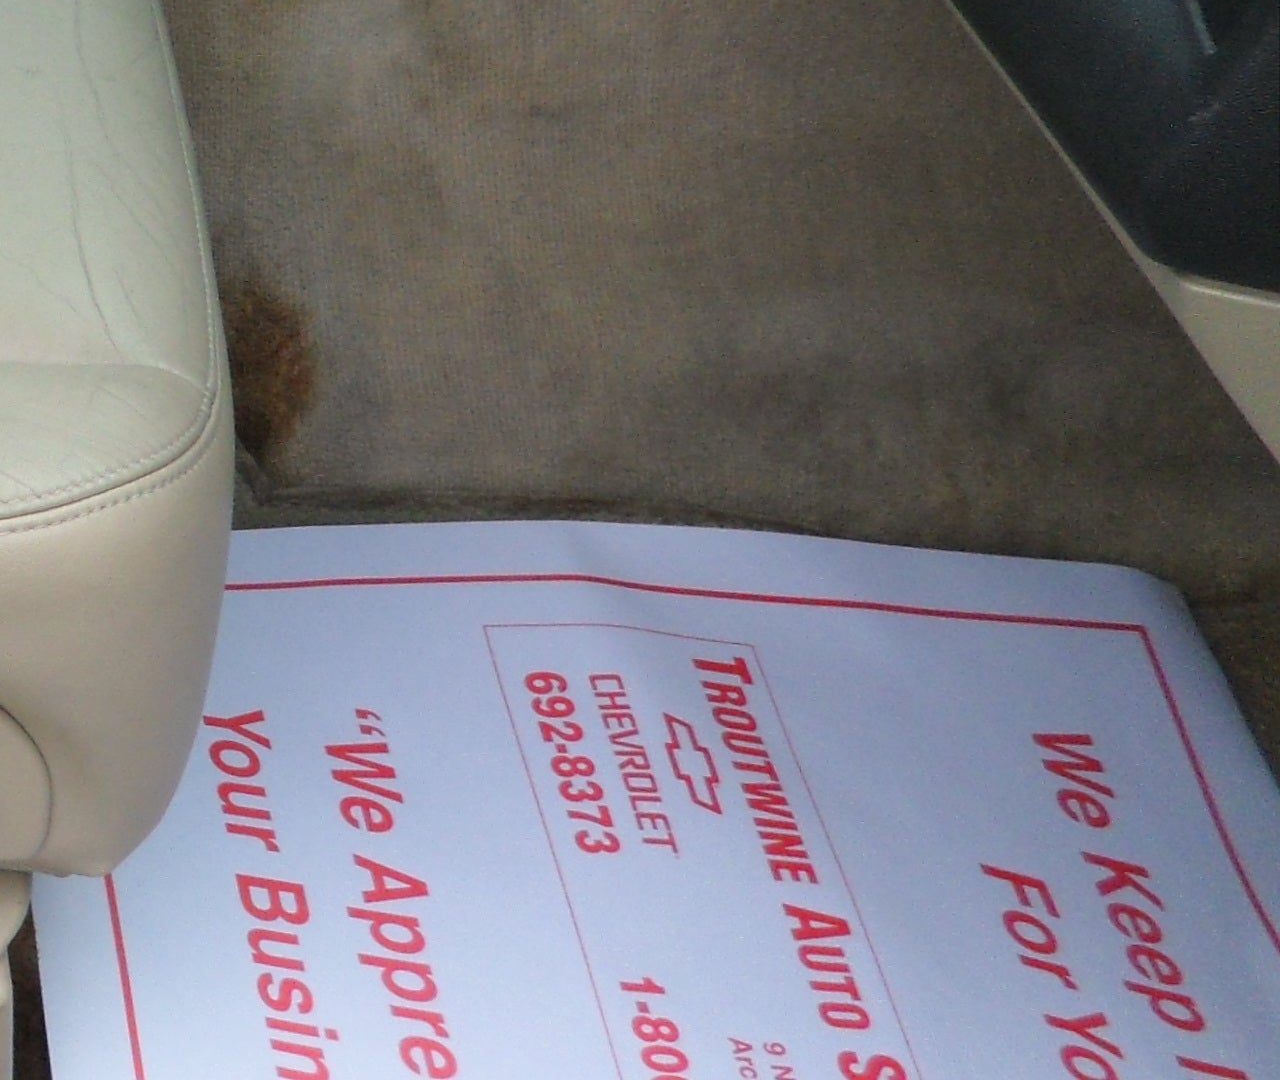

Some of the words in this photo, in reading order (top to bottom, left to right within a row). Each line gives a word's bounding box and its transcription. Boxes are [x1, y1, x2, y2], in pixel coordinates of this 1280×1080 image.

[203, 709, 280, 853] Your
[524, 671, 621, 855] 692-8373
[588, 673, 679, 856] CHEVROLET
[692, 656, 819, 885] TROUTWINE
[782, 903, 872, 1031] AUTO
[346, 854, 458, 1080] Appre
[980, 864, 1078, 991] For
[1031, 731, 1113, 831] We
[1080, 850, 1206, 1033] Keep
[235, 873, 340, 1080] Busin
[619, 977, 692, 1080] 1-80
